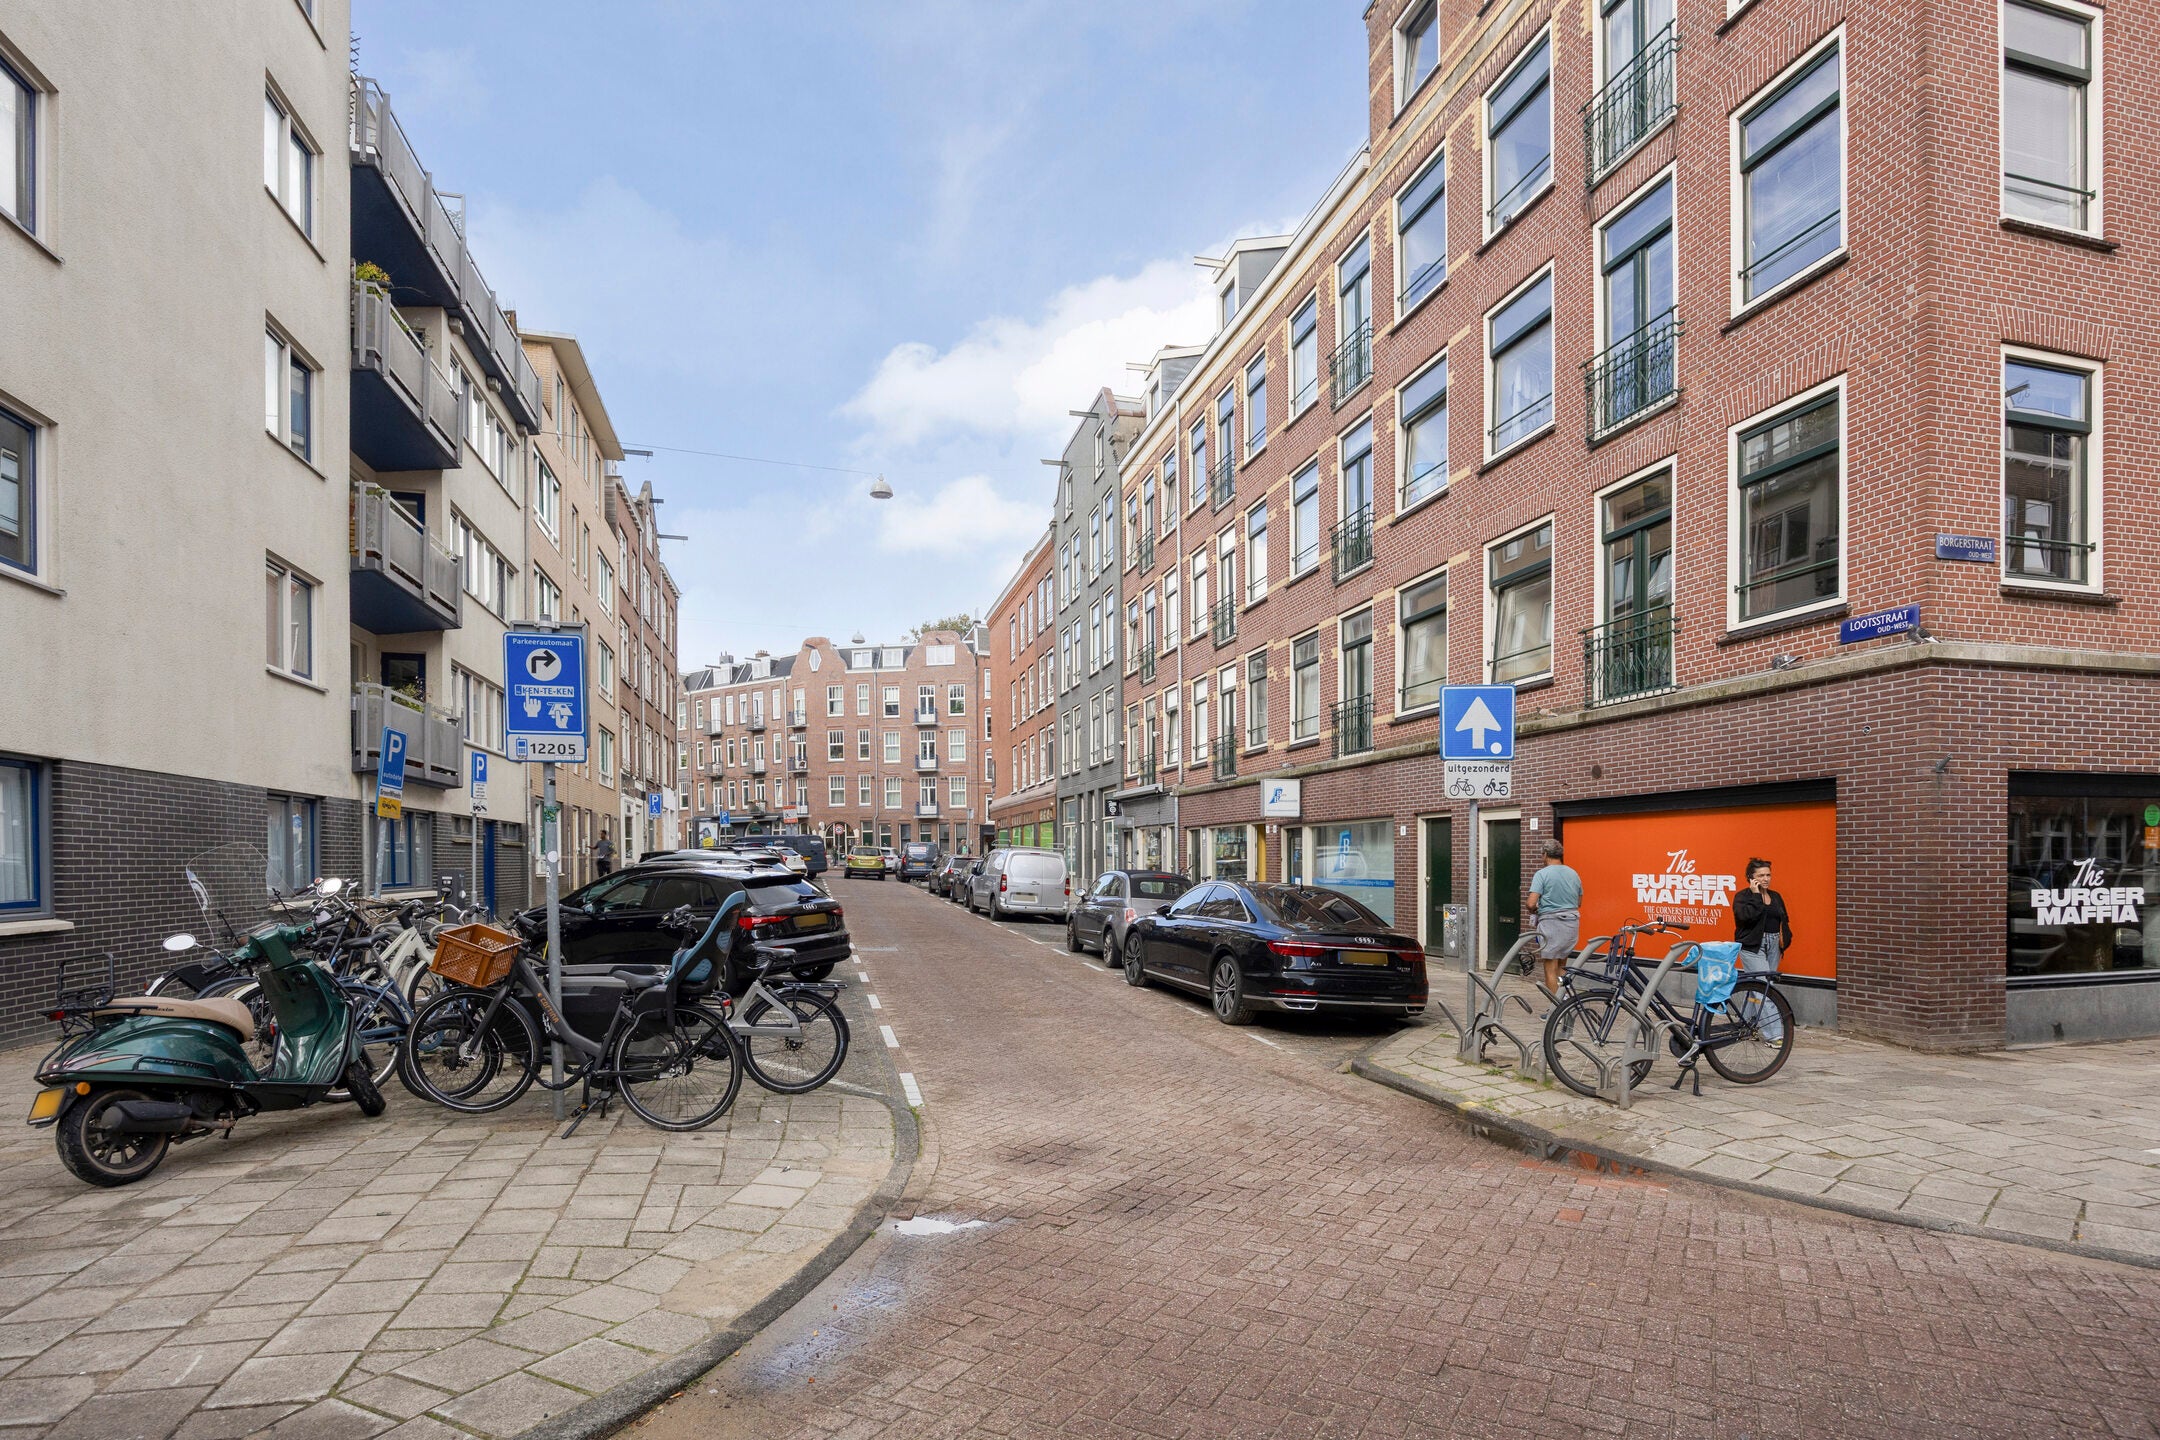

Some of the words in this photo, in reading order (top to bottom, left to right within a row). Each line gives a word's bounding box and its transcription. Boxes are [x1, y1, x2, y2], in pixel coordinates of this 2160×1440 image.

[1939, 536, 1993, 550] BORGERSTRAAT
[1968, 551, 1993, 559] OUD-WEST
[1850, 610, 1909, 632] LOOTSSTRAAT
[1877, 621, 1909, 634] OUD-WEST
[512, 638, 573, 647] Parkeerautomaat
[522, 685, 573, 695] KEN-TE-KEN
[388, 734, 402, 762] P
[530, 743, 576, 755] 12205
[476, 756, 485, 779] P
[1448, 764, 1510, 774] uitgezonderd
[651, 796, 659, 805] P
[1666, 849, 1696, 873] The
[2072, 857, 2105, 887] The
[1632, 874, 1736, 891] BURGER
[1637, 888, 1730, 907] MAFFIA
[2031, 887, 2145, 907] BURGER
[1643, 905, 1655, 914] THE
[1655, 906, 1699, 916] CORNERSTONE
[1700, 908, 1708, 917] OF
[1709, 909, 1722, 918] ANY
[2037, 905, 2139, 926] MAFFIA
[1683, 916, 1718, 926] BREAKFAST
